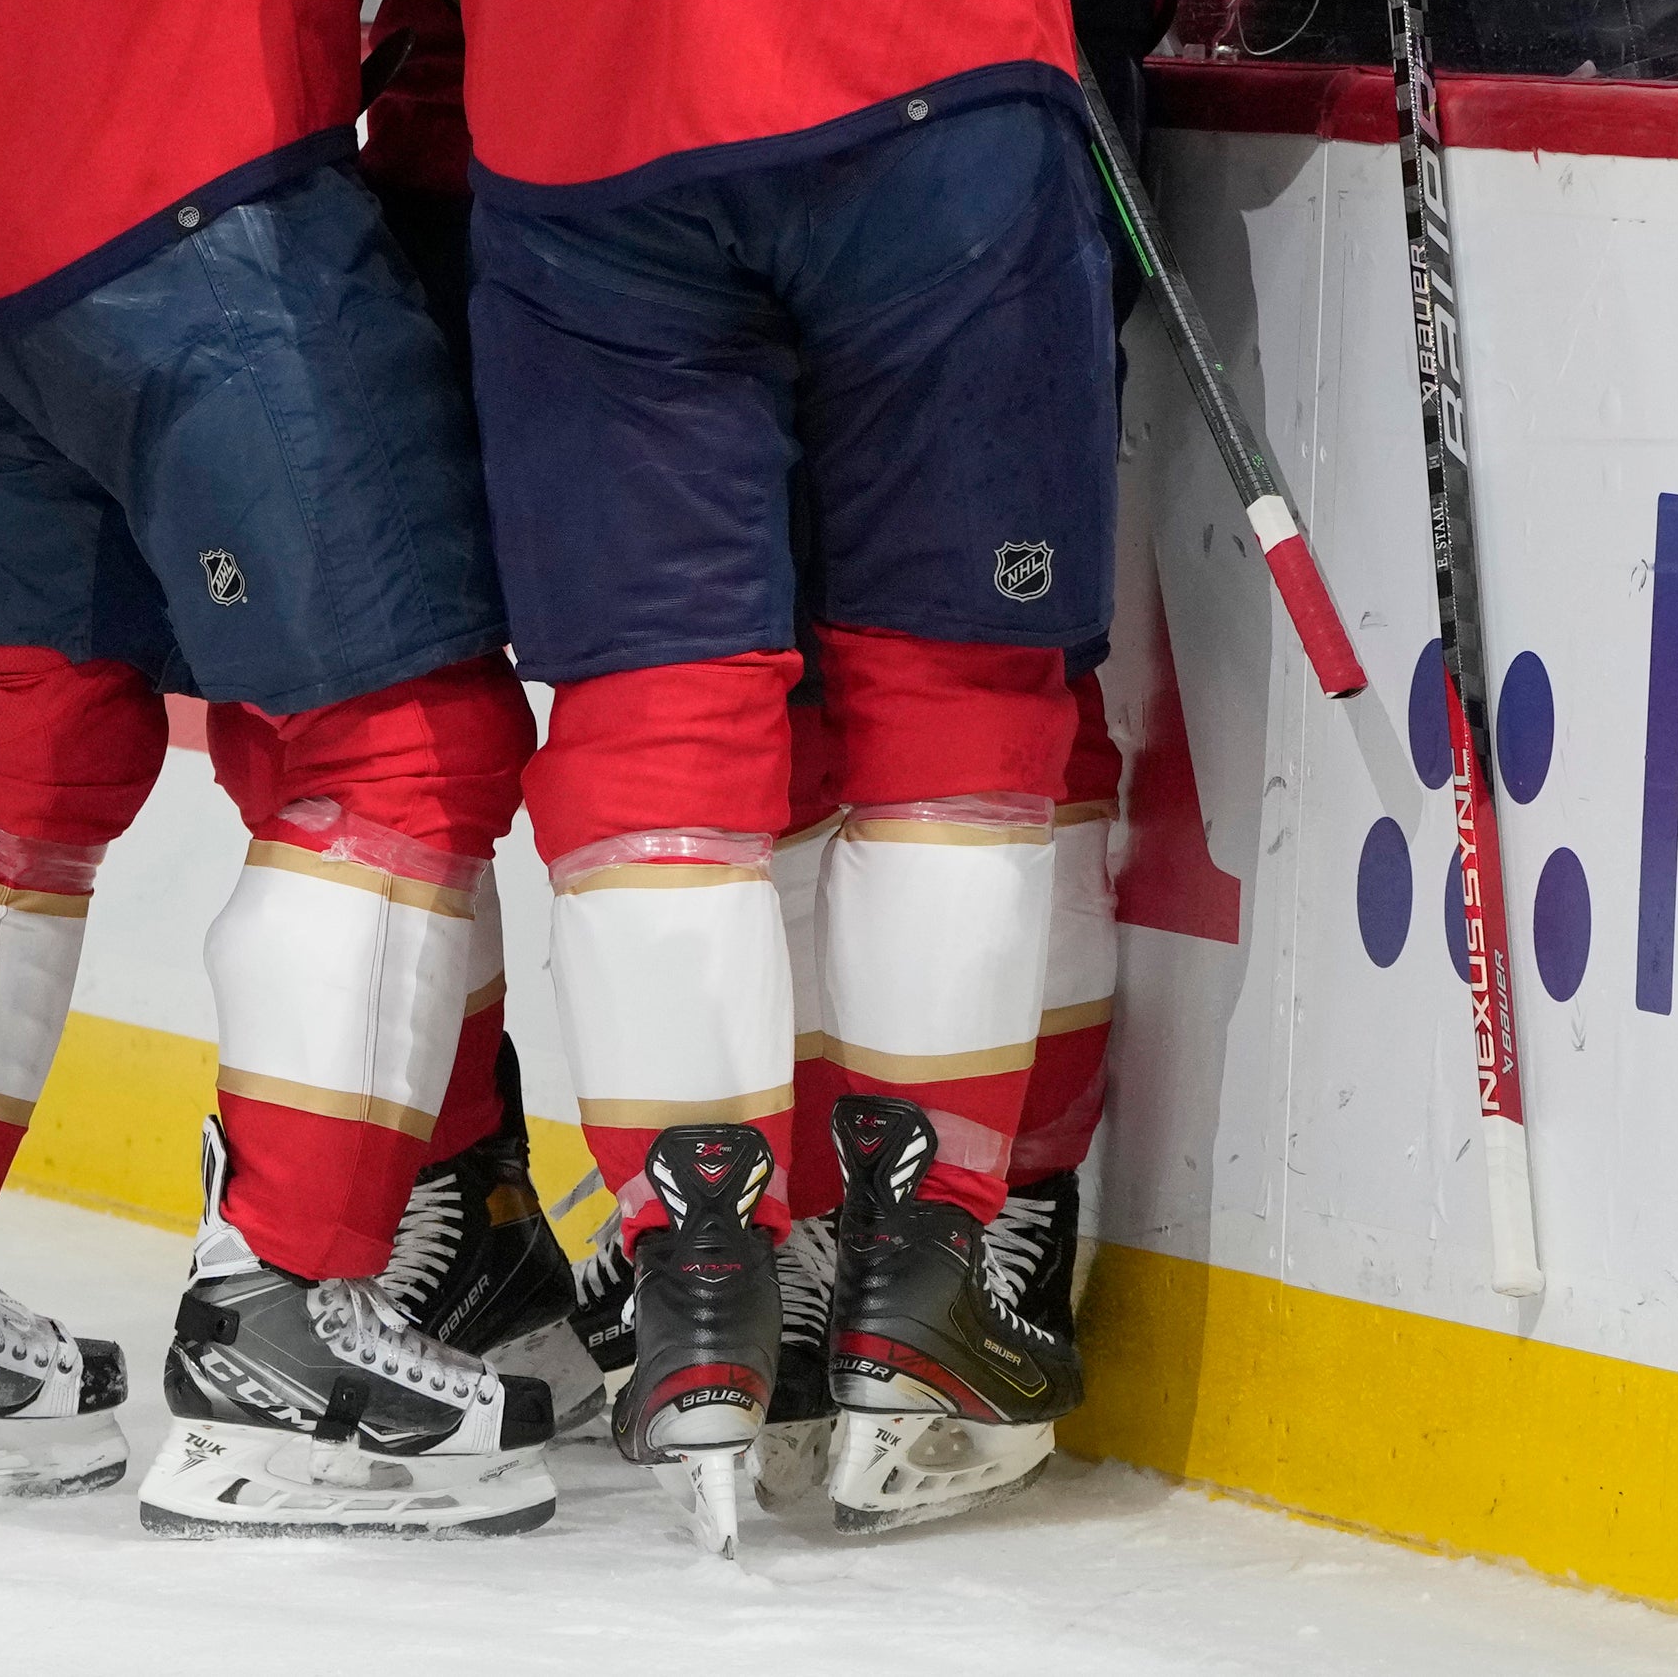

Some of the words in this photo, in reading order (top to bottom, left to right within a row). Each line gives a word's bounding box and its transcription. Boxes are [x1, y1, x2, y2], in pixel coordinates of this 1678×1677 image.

[1435, 498, 1446, 550] STAAL
[216, 558, 234, 594] NHL
[1007, 556, 1043, 588] NHL
[1469, 922, 1502, 1113] NEXUS
[199, 1346, 319, 1432] CCM
